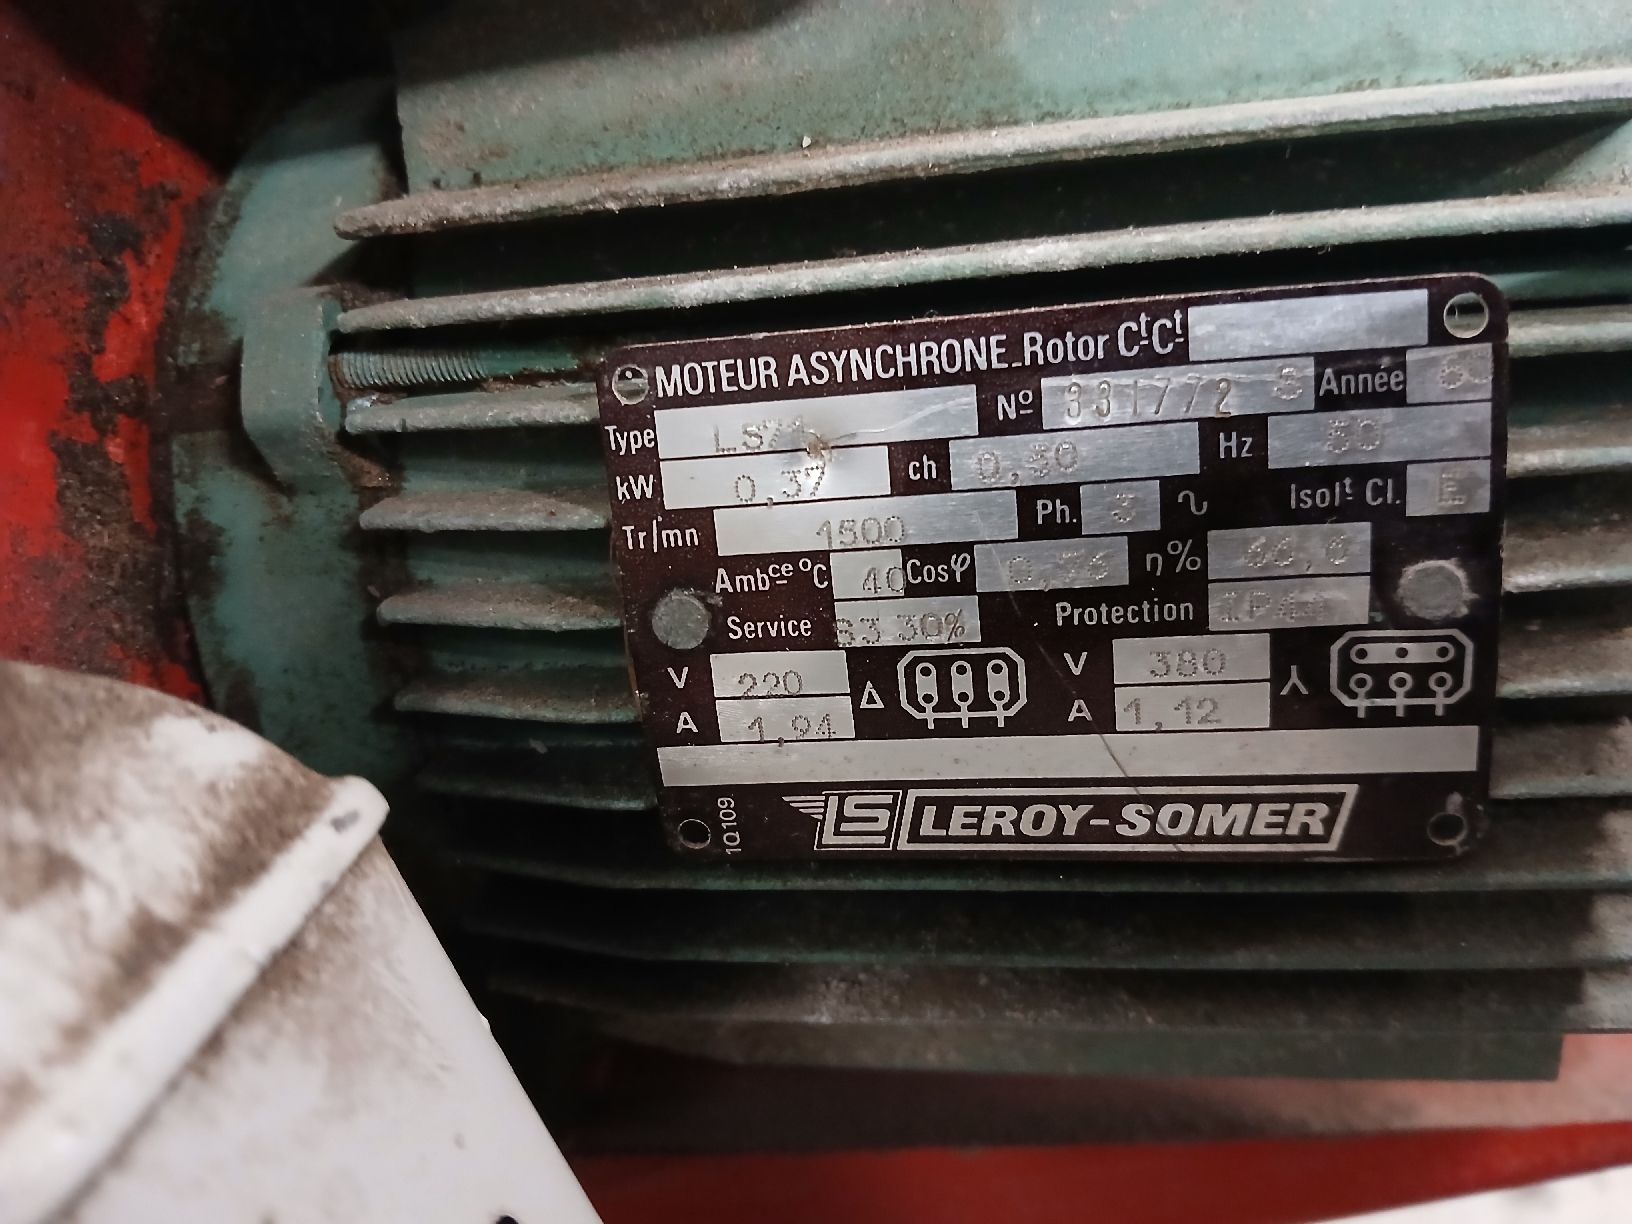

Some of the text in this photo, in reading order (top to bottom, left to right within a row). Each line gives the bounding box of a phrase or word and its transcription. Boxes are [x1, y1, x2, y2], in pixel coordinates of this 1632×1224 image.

[655, 356, 779, 398] MOTEUR
[1319, 364, 1406, 396] Année
[604, 425, 655, 456] Type
[1219, 431, 1253, 459] Hz
[909, 454, 937, 481] ch
[615, 474, 655, 503] kW
[734, 465, 826, 508] 0,37
[1037, 499, 1078, 526] Ph.
[815, 514, 906, 550] 1500
[862, 565, 907, 595] 40
[727, 614, 813, 640] Service
[1056, 598, 1195, 627] Protection
[667, 667, 689, 689] V
[1064, 651, 1088, 676] V
[1150, 647, 1227, 679] 380
[738, 669, 803, 699] 220
[676, 712, 699, 734] A
[1067, 699, 1093, 721] A
[1123, 696, 1222, 732] 1,12
[748, 713, 837, 749] 1,94
[919, 802, 1331, 837] LEROY-SOMER
